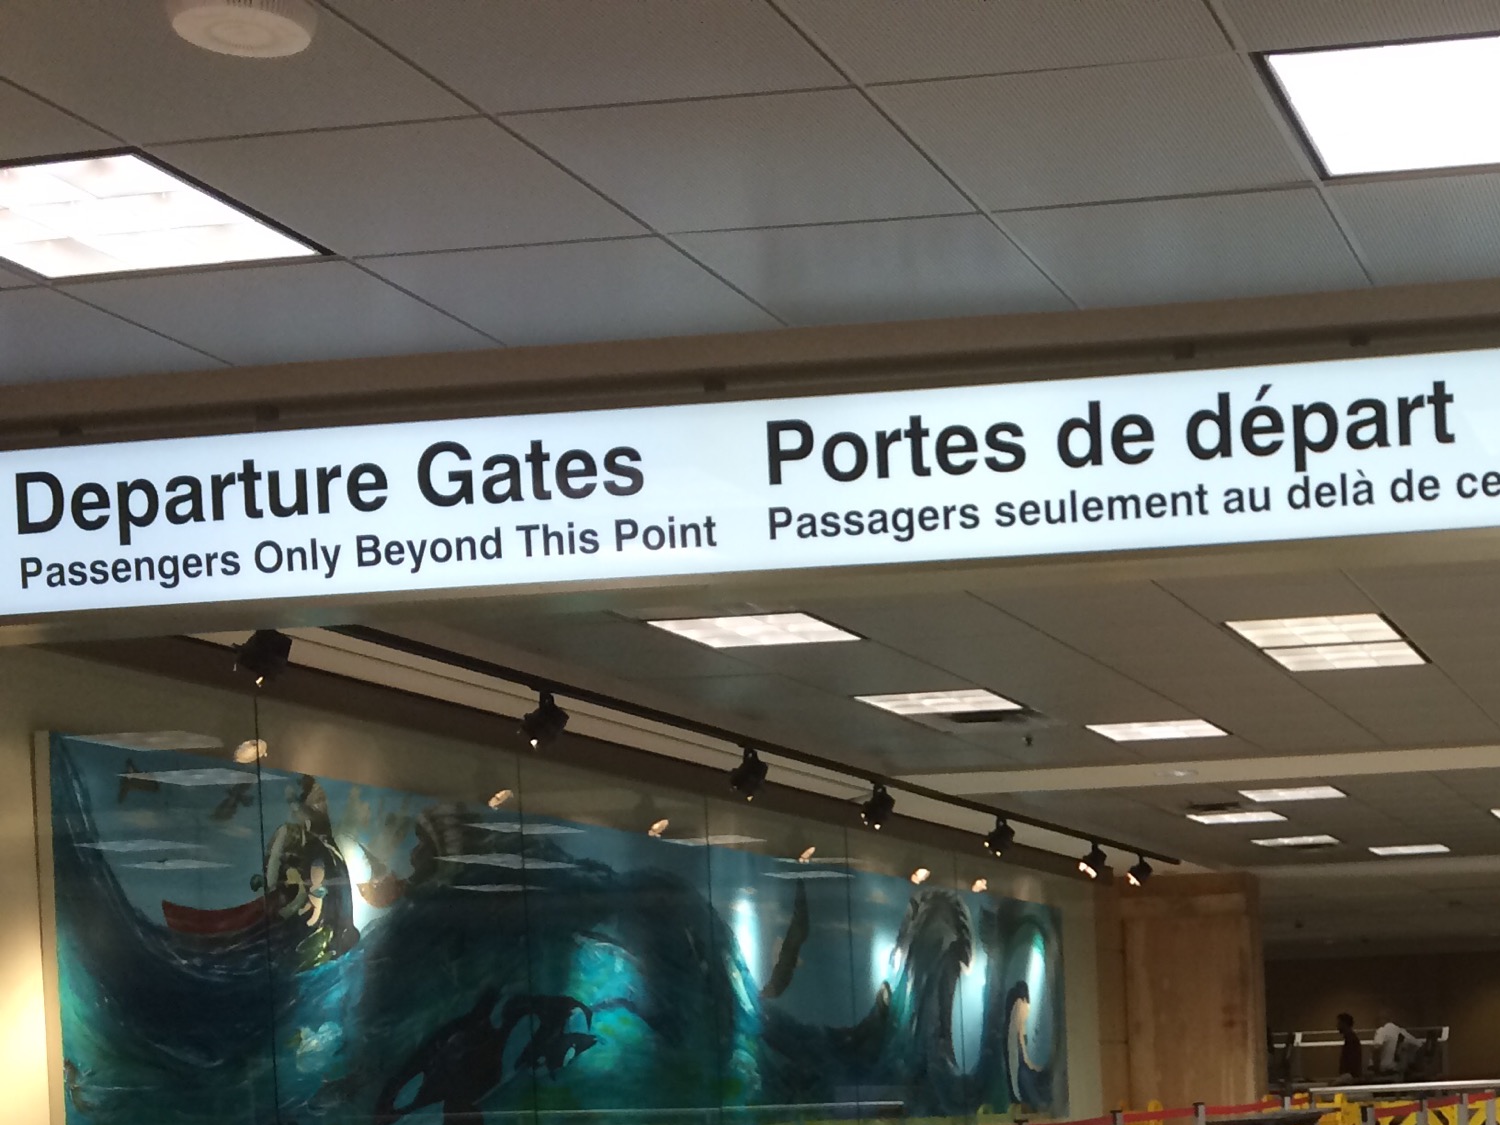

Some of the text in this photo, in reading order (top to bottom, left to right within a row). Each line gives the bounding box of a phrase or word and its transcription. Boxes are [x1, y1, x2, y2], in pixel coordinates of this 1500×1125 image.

[767, 381, 1455, 485] Portes de départ
[16, 440, 643, 545] Departure Gates
[769, 504, 979, 542] Passagers
[996, 484, 1208, 527] seulement
[1224, 487, 1270, 513] au
[1288, 473, 1373, 509] delà
[1391, 469, 1439, 502] de
[21, 517, 716, 589] Passengers Only Beyond This Point
